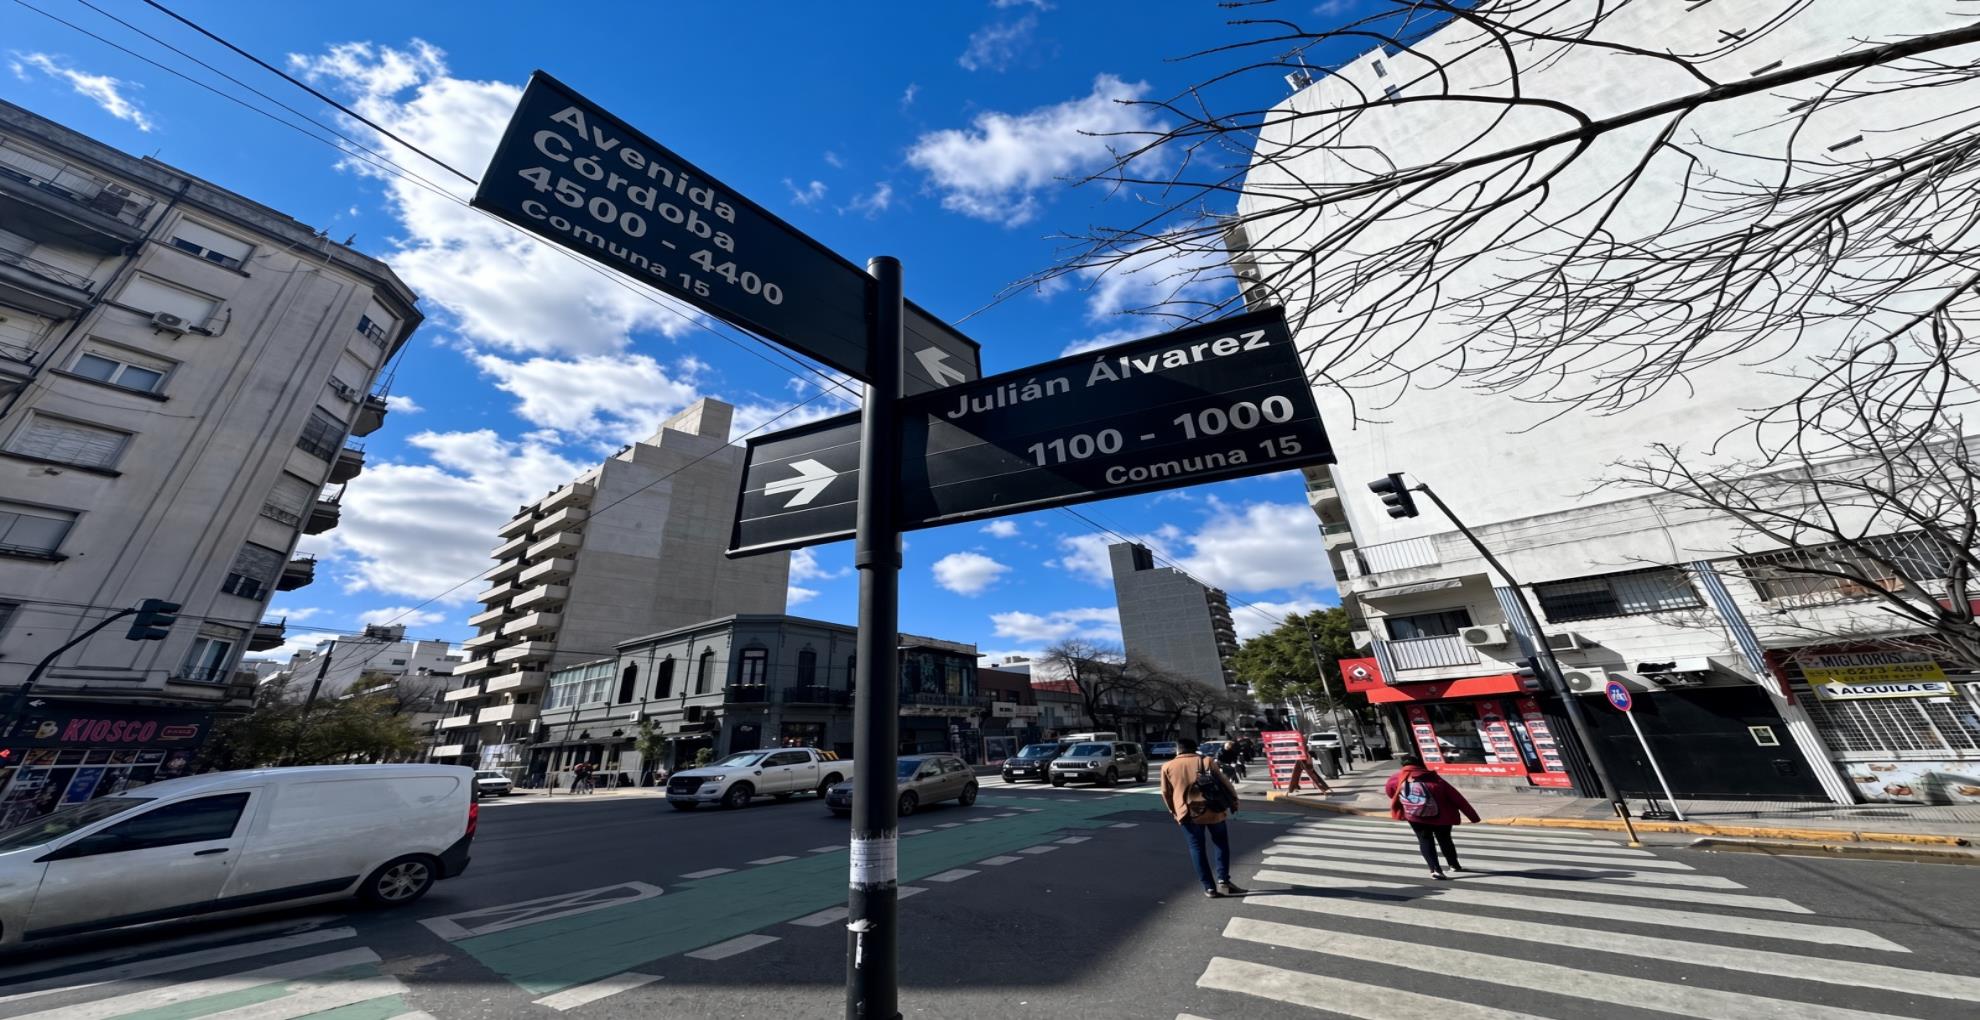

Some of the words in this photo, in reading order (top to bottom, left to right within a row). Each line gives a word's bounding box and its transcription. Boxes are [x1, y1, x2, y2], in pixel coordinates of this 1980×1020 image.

[533, 130, 736, 253] Córdoba
[550, 106, 736, 224] Avenida
[518, 166, 647, 238] 4500
[661, 239, 677, 251] -
[689, 249, 784, 305] 4400
[521, 200, 668, 279] Comuna
[679, 272, 711, 298] 15
[947, 375, 1070, 420] Julián
[1085, 328, 1270, 387] Álvarez
[1027, 428, 1124, 467] 1100
[1139, 432, 1156, 442] -
[1173, 395, 1295, 440] 1000
[1105, 446, 1248, 485] Comuna
[1258, 435, 1302, 459] 15
[60, 718, 158, 742] KIOSCO
[1841, 684, 1921, 695] ALQUILA
